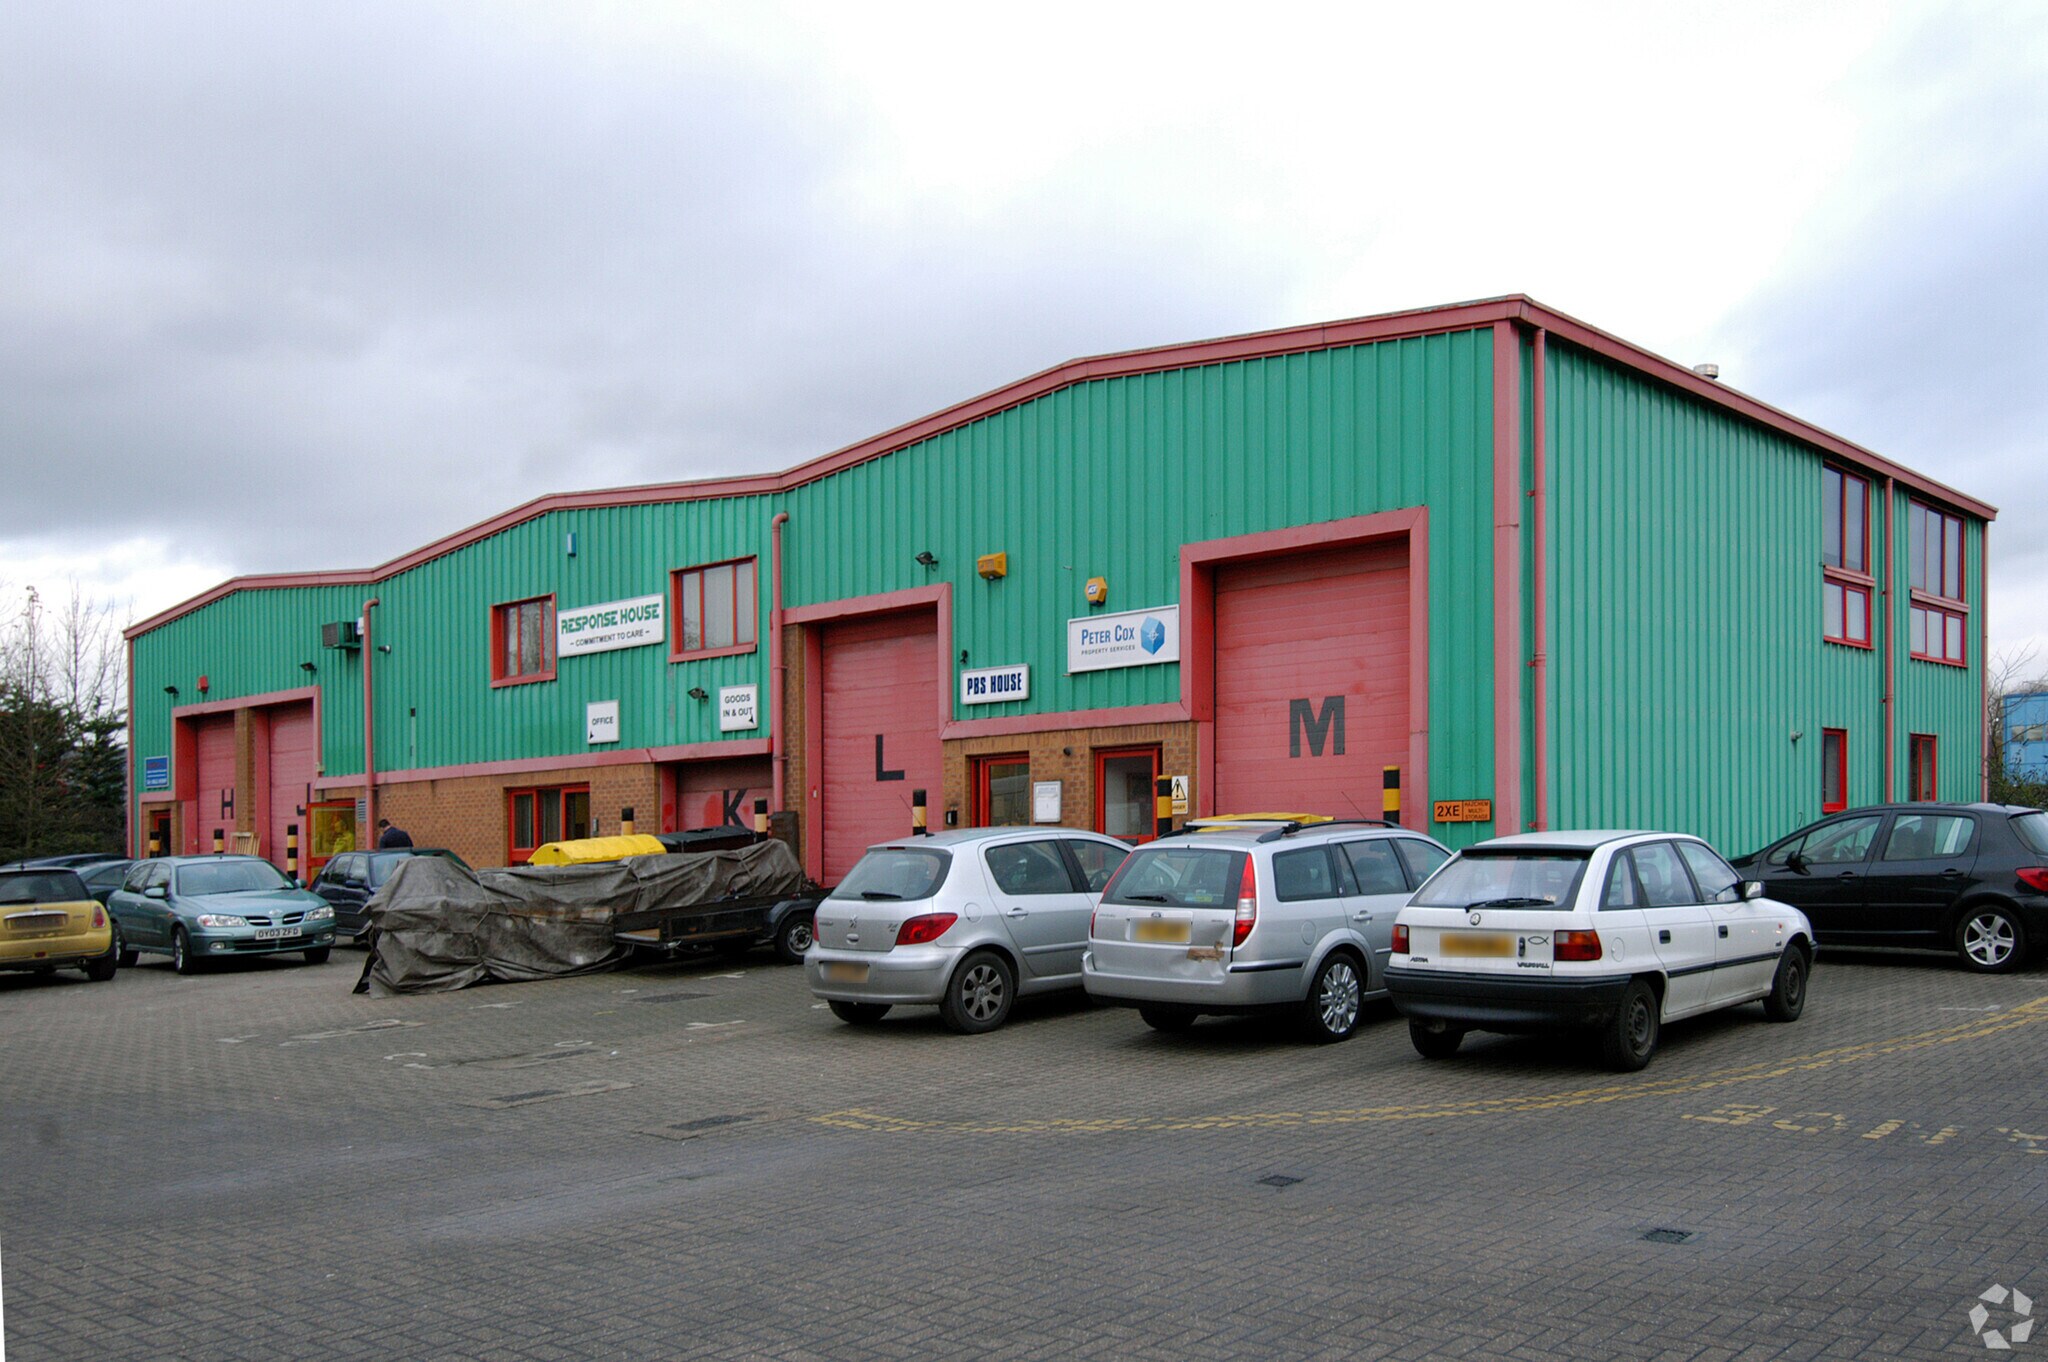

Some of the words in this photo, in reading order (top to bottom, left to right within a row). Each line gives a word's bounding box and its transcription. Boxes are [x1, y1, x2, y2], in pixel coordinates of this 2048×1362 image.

[561, 610, 618, 634] RESPONSE
[620, 603, 660, 625] HOUSE
[617, 631, 626, 640] TO
[1081, 647, 1109, 655] PROPERTY
[1110, 644, 1136, 653] SERVICES
[967, 676, 986, 695] PBS
[990, 672, 1022, 693] HOUSE
[724, 693, 751, 704] GOODS
[723, 708, 730, 717] IN
[731, 708, 737, 716] &
[738, 706, 753, 716] OUT
[592, 715, 614, 726] OFFICE
[1289, 695, 1346, 758] M
[875, 734, 905, 781] L
[221, 788, 234, 820] H
[723, 788, 748, 827] K
[1437, 805, 1460, 817] 2XE
